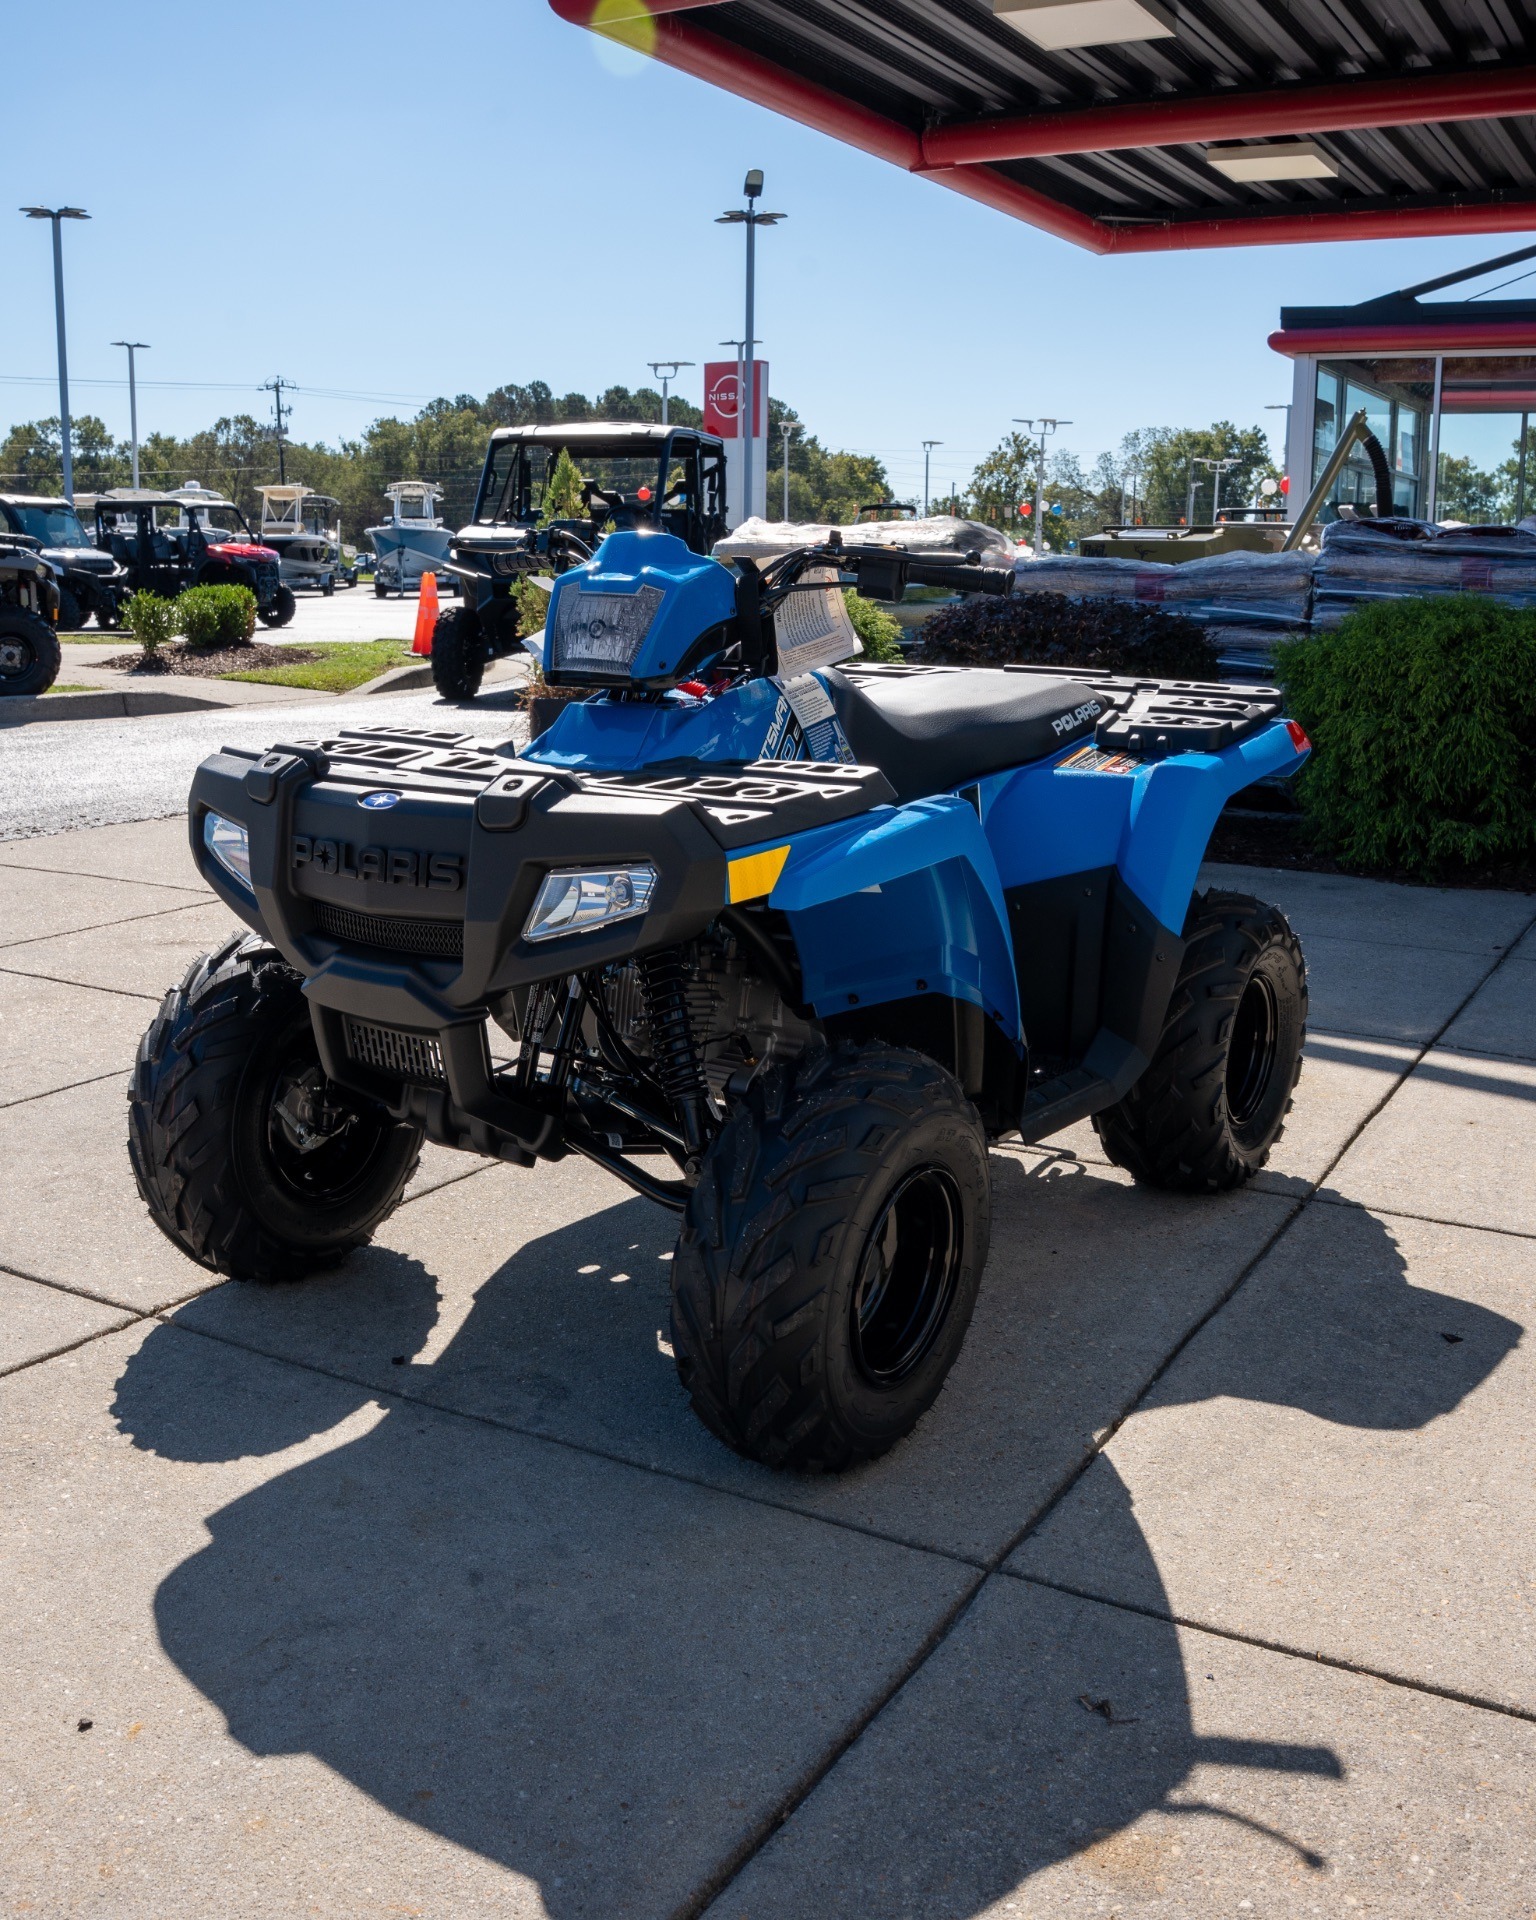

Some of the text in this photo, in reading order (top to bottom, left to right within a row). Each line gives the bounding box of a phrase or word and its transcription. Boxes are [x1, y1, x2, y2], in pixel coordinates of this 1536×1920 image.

[709, 392, 738, 401] NISS
[1051, 700, 1101, 736] POLARIS
[292, 835, 463, 892] POLARIS
